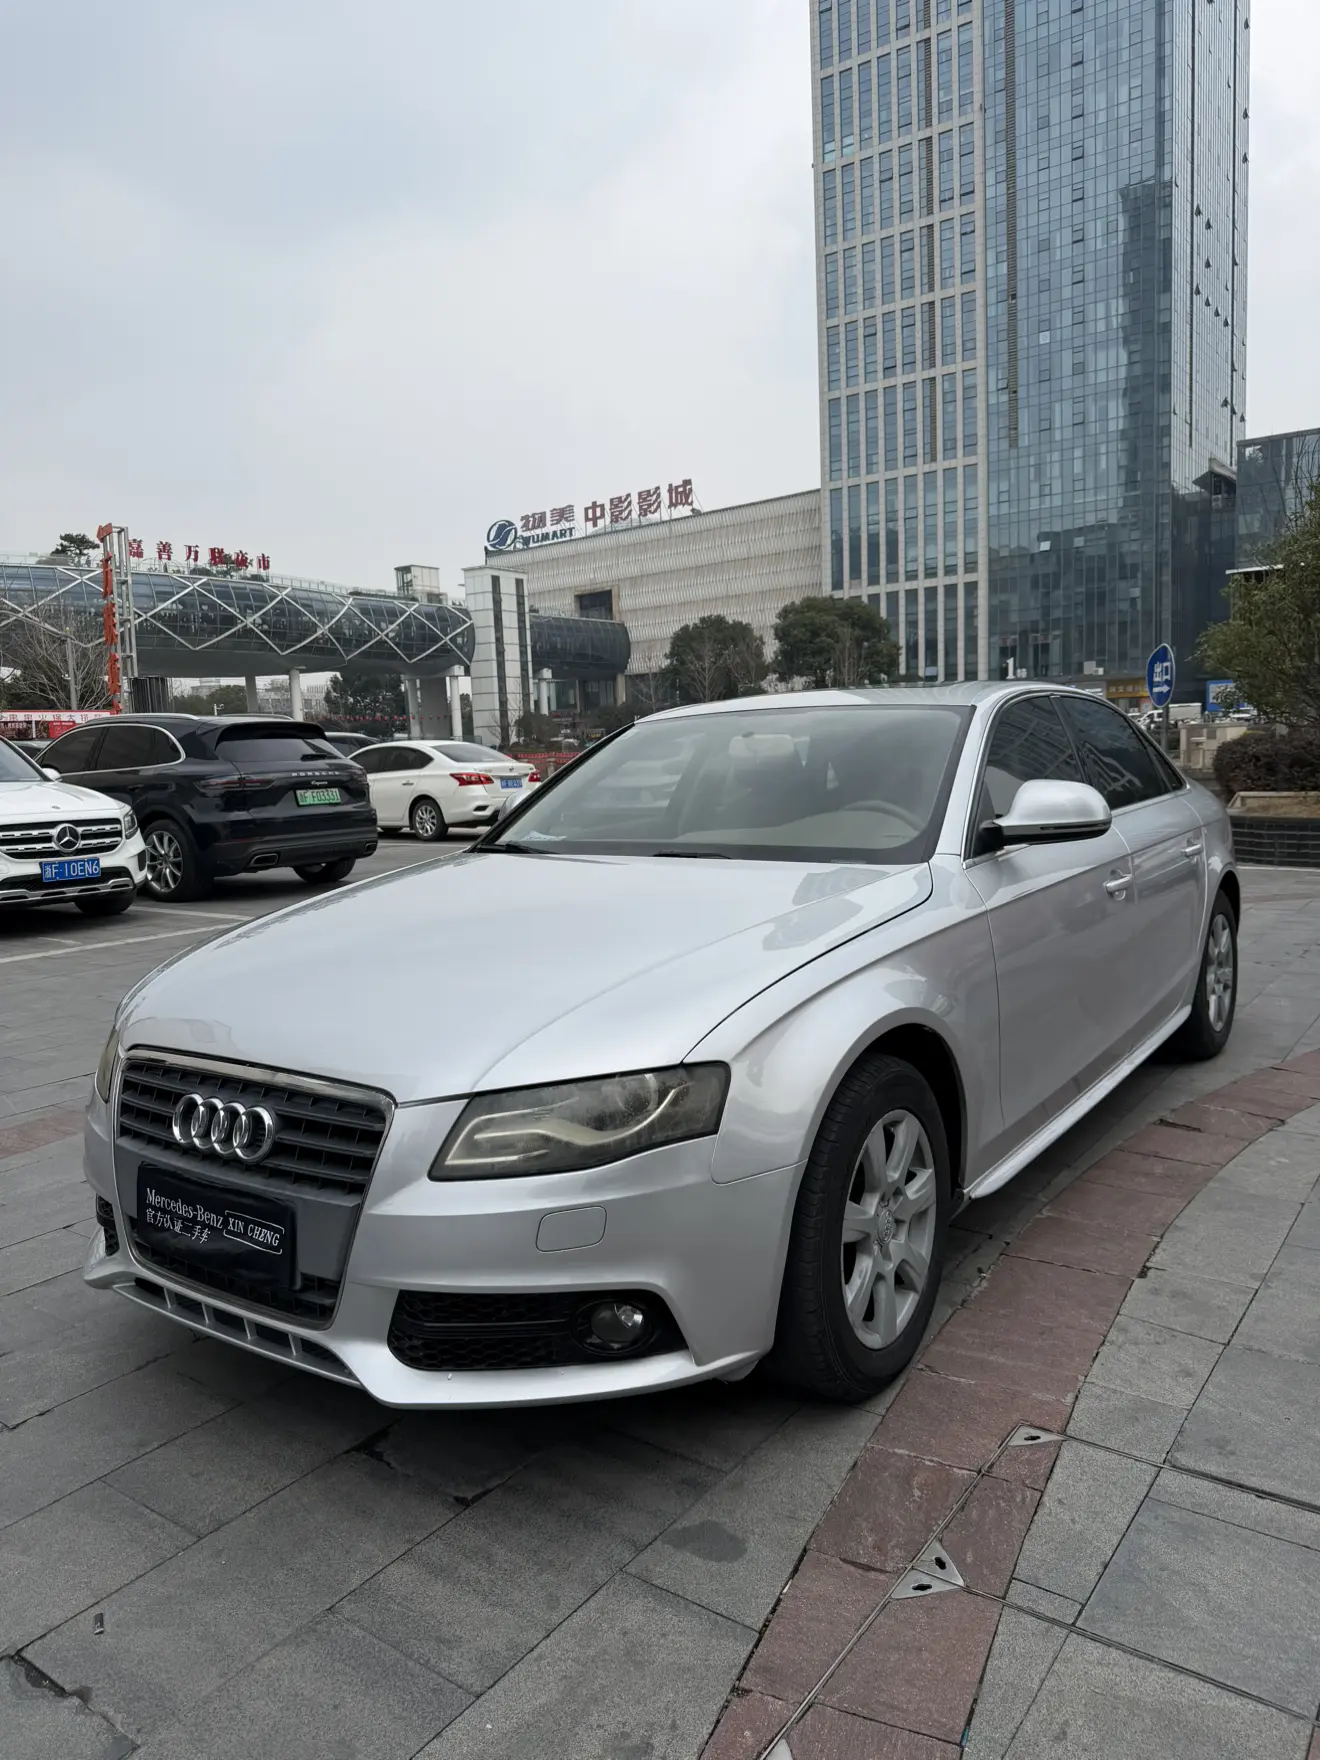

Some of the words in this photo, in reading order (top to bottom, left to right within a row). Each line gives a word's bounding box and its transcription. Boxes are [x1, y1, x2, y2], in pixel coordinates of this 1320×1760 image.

[520, 504, 575, 532] 物美
[584, 479, 693, 528] 中影影城
[521, 527, 575, 547] WUMART
[128, 538, 271, 571] 嘉善万联夜市
[1154, 662, 1171, 681] 出口
[146, 1188, 223, 1229] Mercedes-Benz
[227, 1217, 245, 1234] XIN
[247, 1224, 280, 1247] CHENG
[146, 1208, 211, 1244] 官方认证二手车
